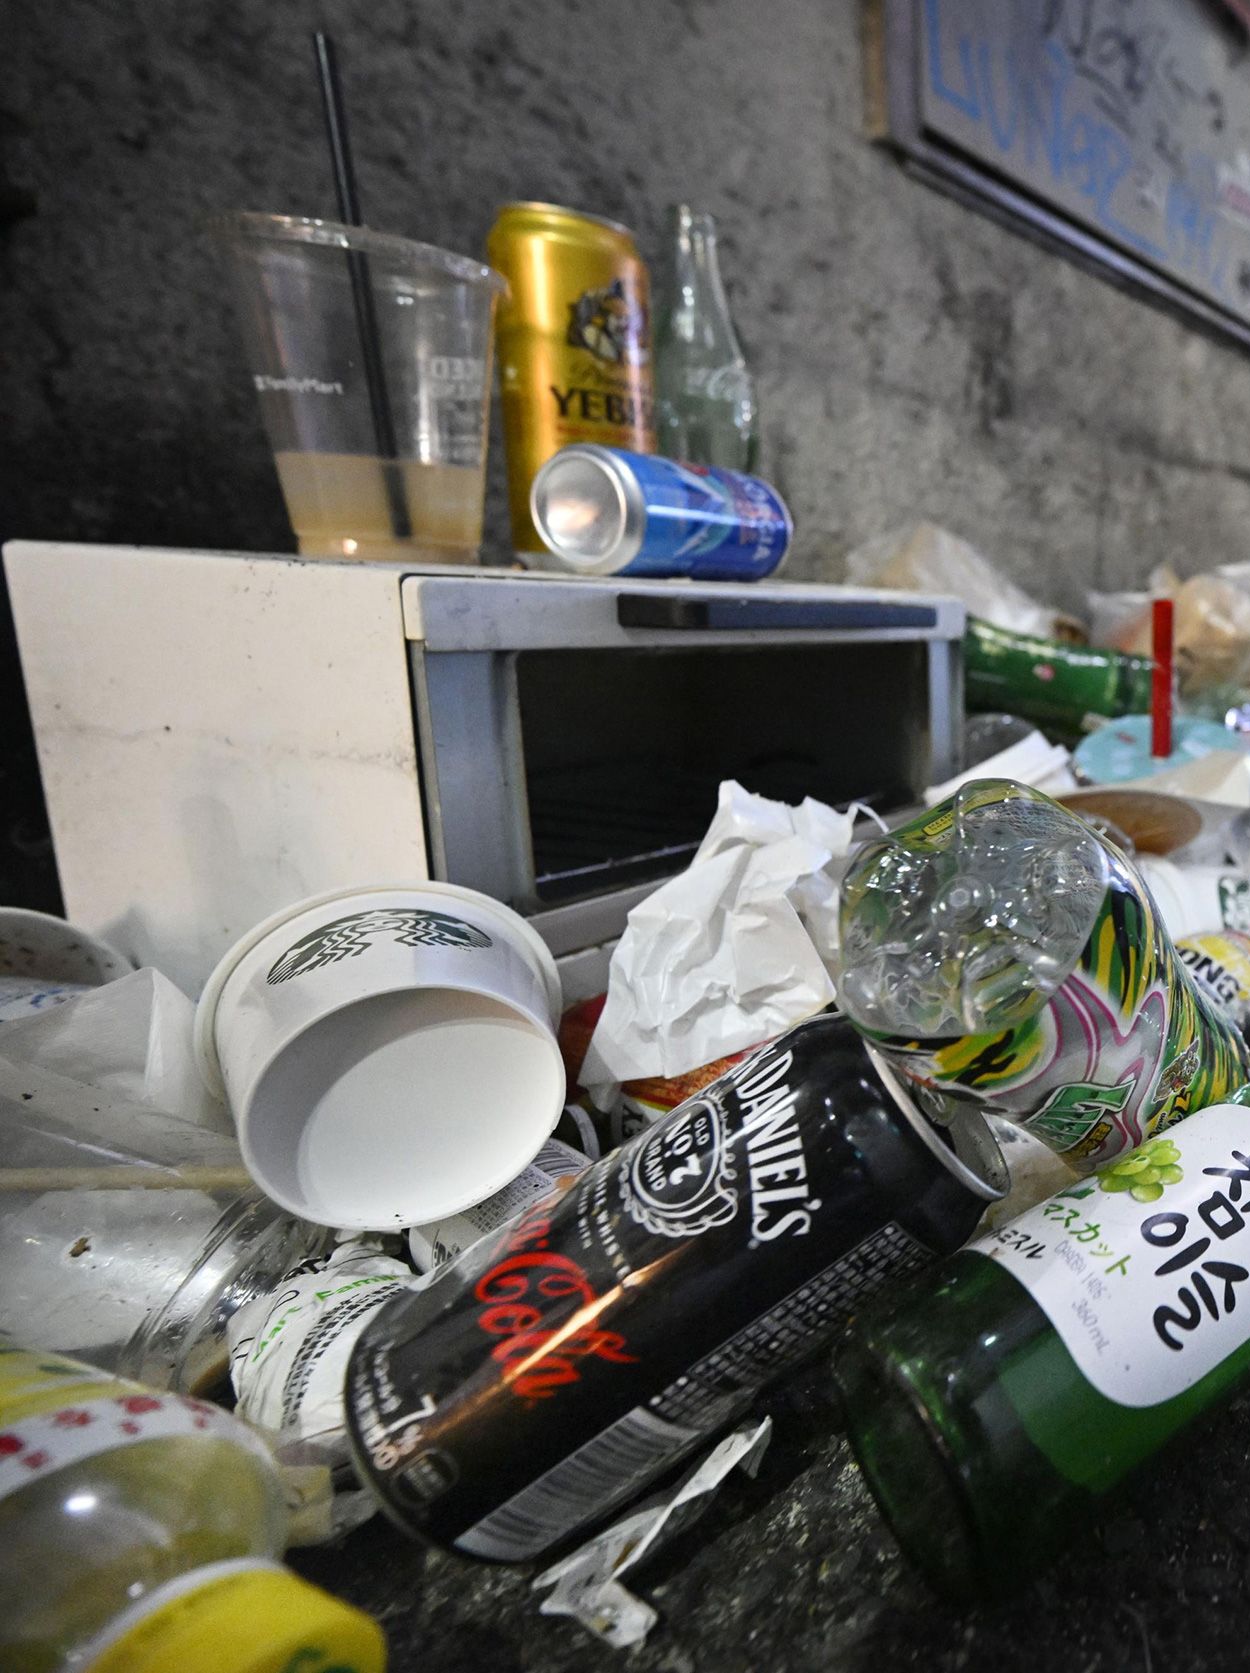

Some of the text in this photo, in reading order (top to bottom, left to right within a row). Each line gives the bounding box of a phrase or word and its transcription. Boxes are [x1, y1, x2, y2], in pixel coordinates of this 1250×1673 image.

[694, 1116, 711, 1146] OLD
[734, 1050, 823, 1242] DANIEL'S
[644, 1137, 668, 1192] BRAND
[988, 1225, 1046, 1259] ミスル
[1043, 1203, 1132, 1277] マスカット
